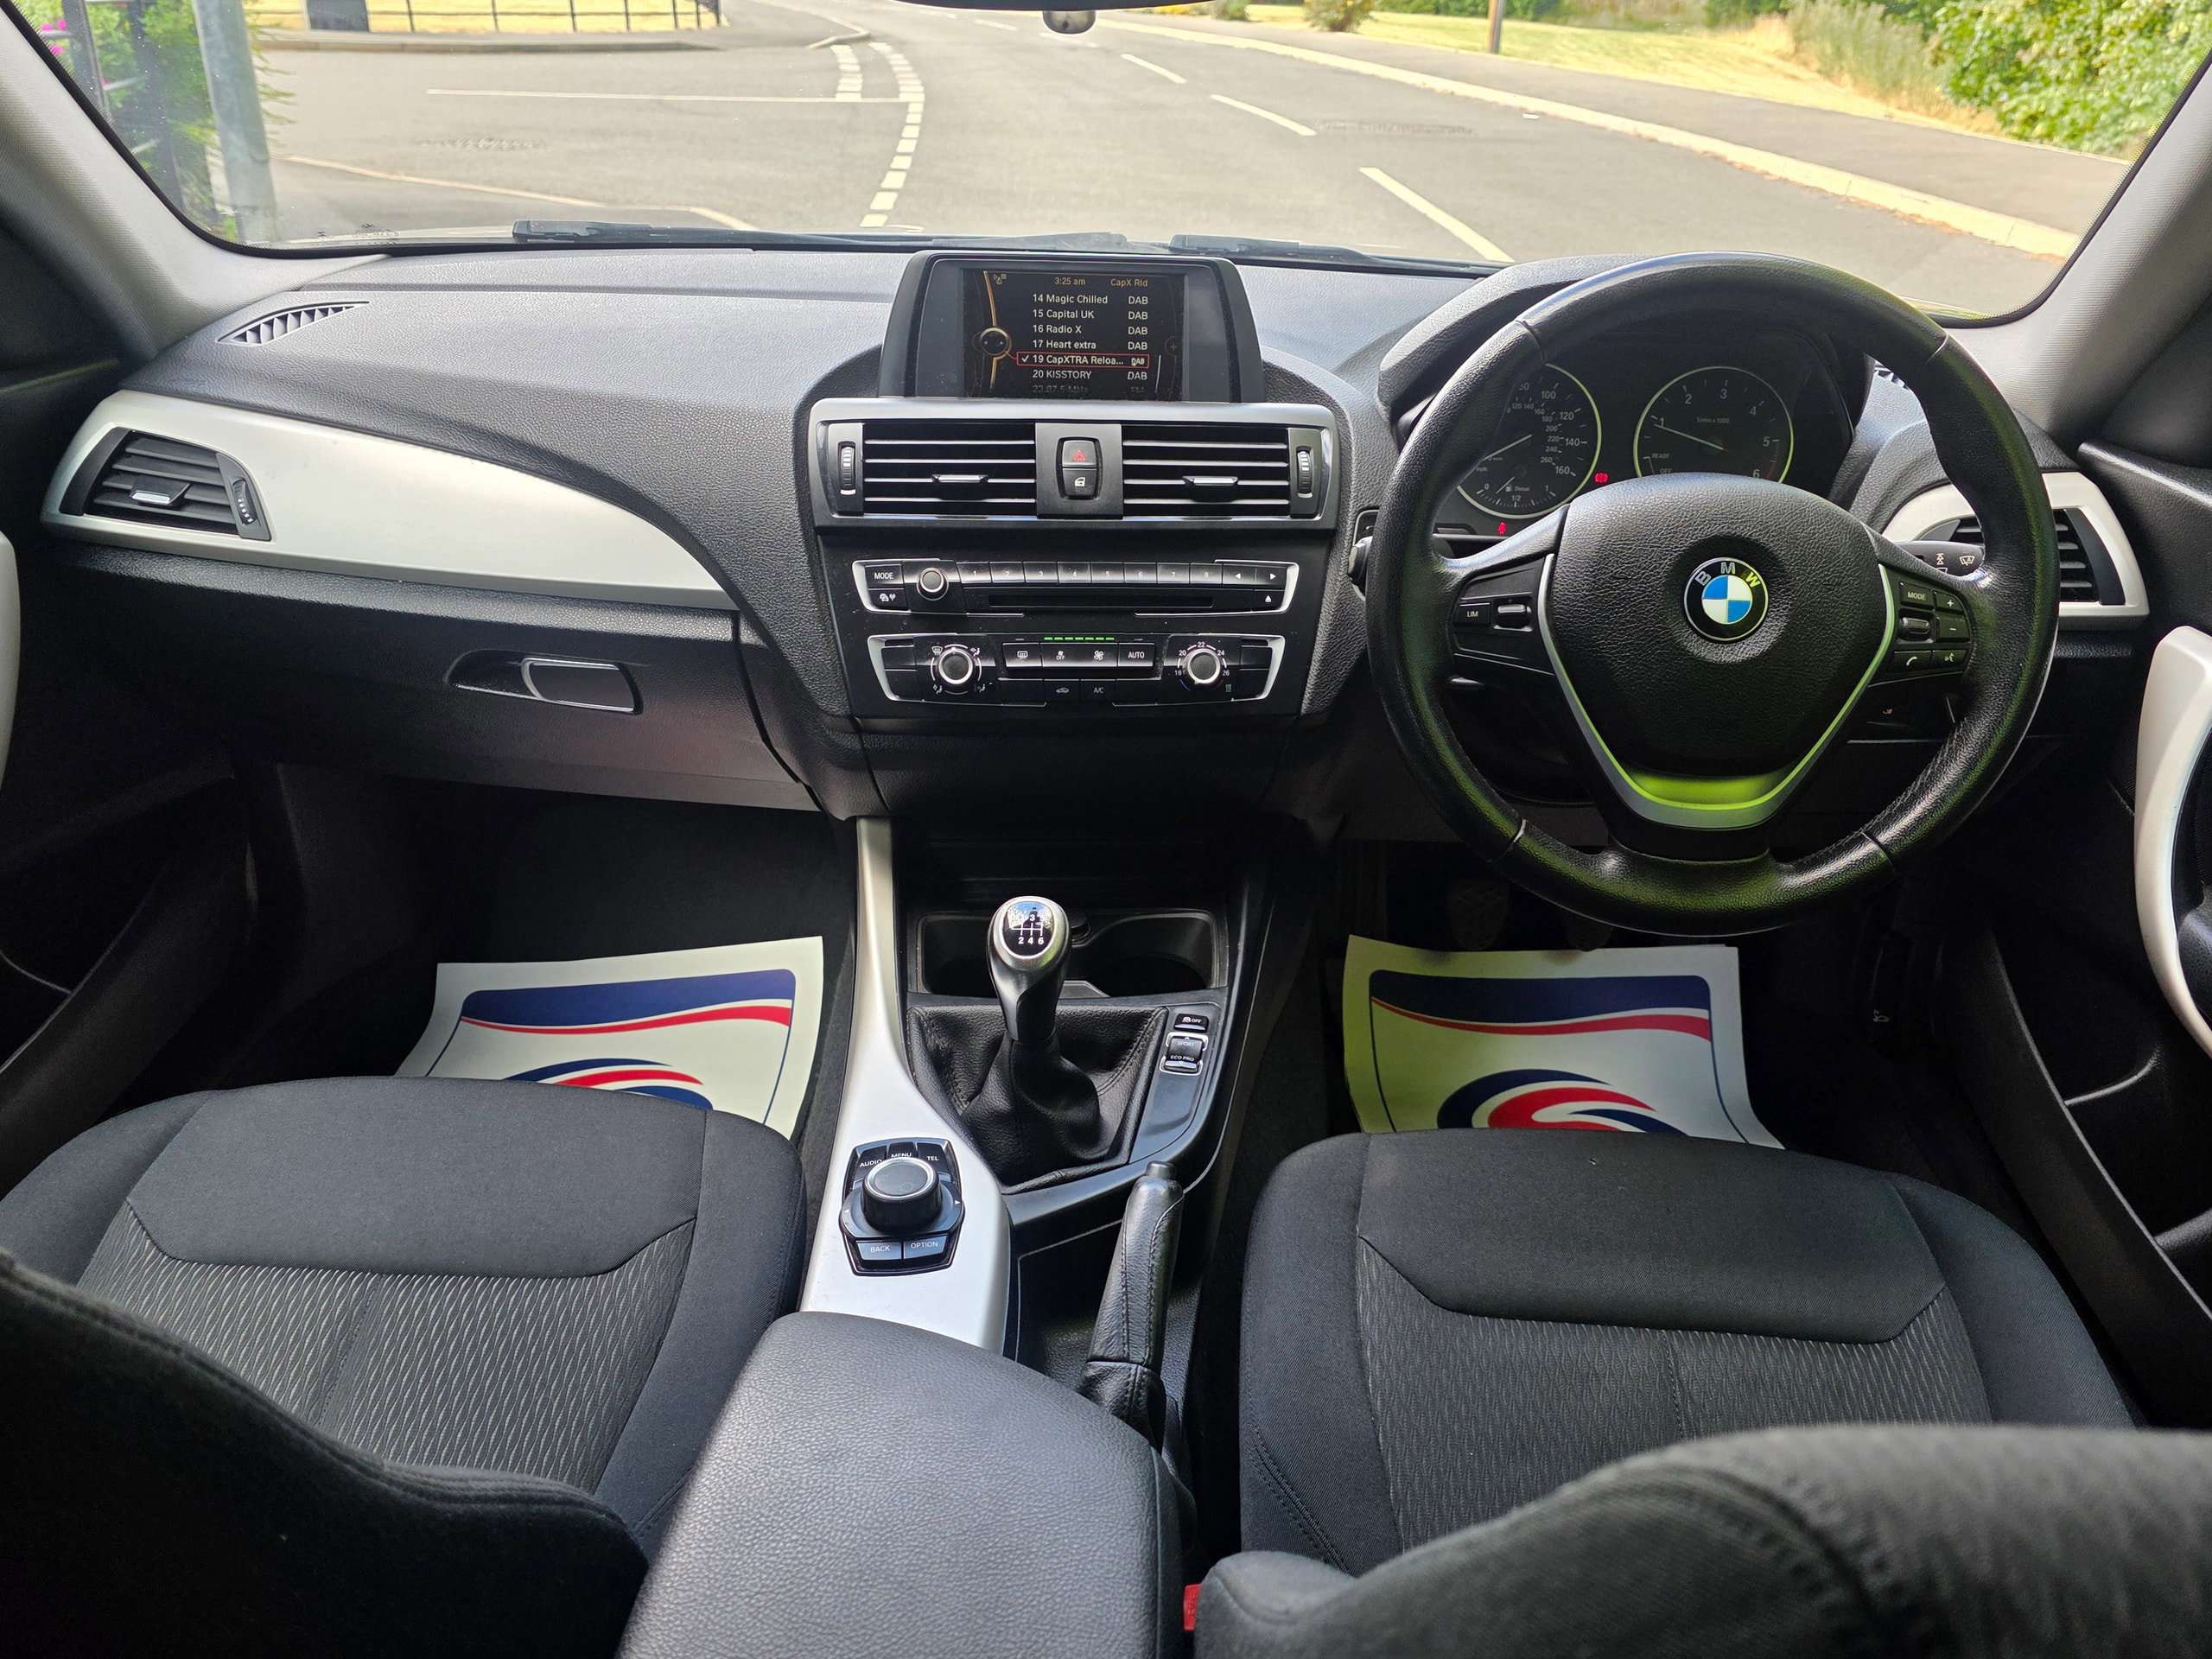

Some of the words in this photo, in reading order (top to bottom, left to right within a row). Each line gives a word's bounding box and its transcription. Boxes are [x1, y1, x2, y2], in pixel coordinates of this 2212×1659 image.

[1054, 277, 1071, 286] 3:25
[1110, 278, 1132, 288] CapX
[1033, 294, 1044, 302] 14
[1046, 294, 1075, 305] Magic
[1077, 295, 1108, 304] Chilled
[1128, 296, 1148, 305] DAB
[1033, 309, 1044, 318] 15
[1046, 309, 1078, 321] Capital
[1080, 310, 1095, 319] UK
[1128, 311, 1148, 320] DAB
[1033, 324, 1044, 333] 16
[1046, 324, 1073, 334] Radio
[1075, 325, 1083, 334] X
[1128, 326, 1148, 335] DAB
[1033, 340, 1044, 348] 17
[1046, 340, 1072, 349] Heart
[1073, 340, 1096, 350] extra
[1128, 341, 1148, 351] DAB
[1033, 354, 1044, 363] 19
[1046, 354, 1089, 365] CapXTRA
[1090, 355, 1124, 365] Reloa...
[1032, 369, 1044, 378] 20
[1046, 370, 1092, 379] KISSTORY
[1127, 371, 1147, 380] DAB
[1541, 390, 1556, 400] 100
[1685, 393, 1694, 405] 2
[1719, 389, 1728, 400] 3
[1749, 405, 1758, 416] 4
[1559, 411, 1574, 421] 120
[1565, 437, 1580, 447] 140
[1762, 436, 1770, 448] 5
[1555, 466, 1571, 475] 160
[1752, 468, 1761, 479] 6
[874, 571, 894, 581] MODE
[1694, 562, 1762, 588] BMW
[1907, 591, 1926, 601] MODE
[859, 1159, 883, 1168] AUDIO
[910, 1241, 938, 1249] OPTION
